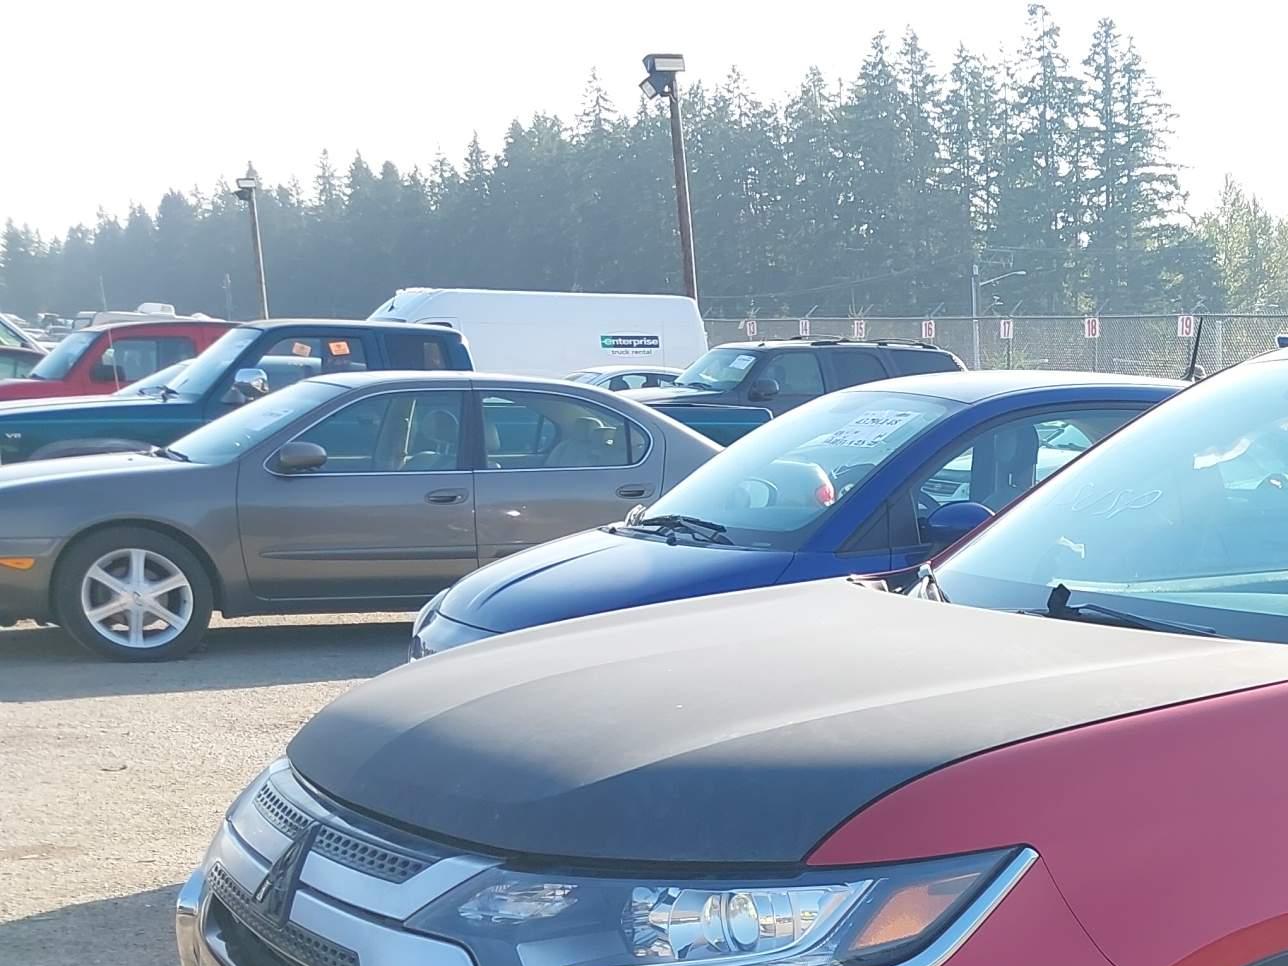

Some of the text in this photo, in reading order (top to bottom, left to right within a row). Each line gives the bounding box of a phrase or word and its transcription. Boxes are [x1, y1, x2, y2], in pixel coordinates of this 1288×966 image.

[800, 320, 809, 335] 14
[854, 321, 864, 337] 15
[923, 321, 934, 337] 16
[1002, 321, 1012, 337] 17
[1087, 318, 1098, 337] 18
[1180, 317, 1192, 336] 19
[602, 337, 658, 347] enterprise
